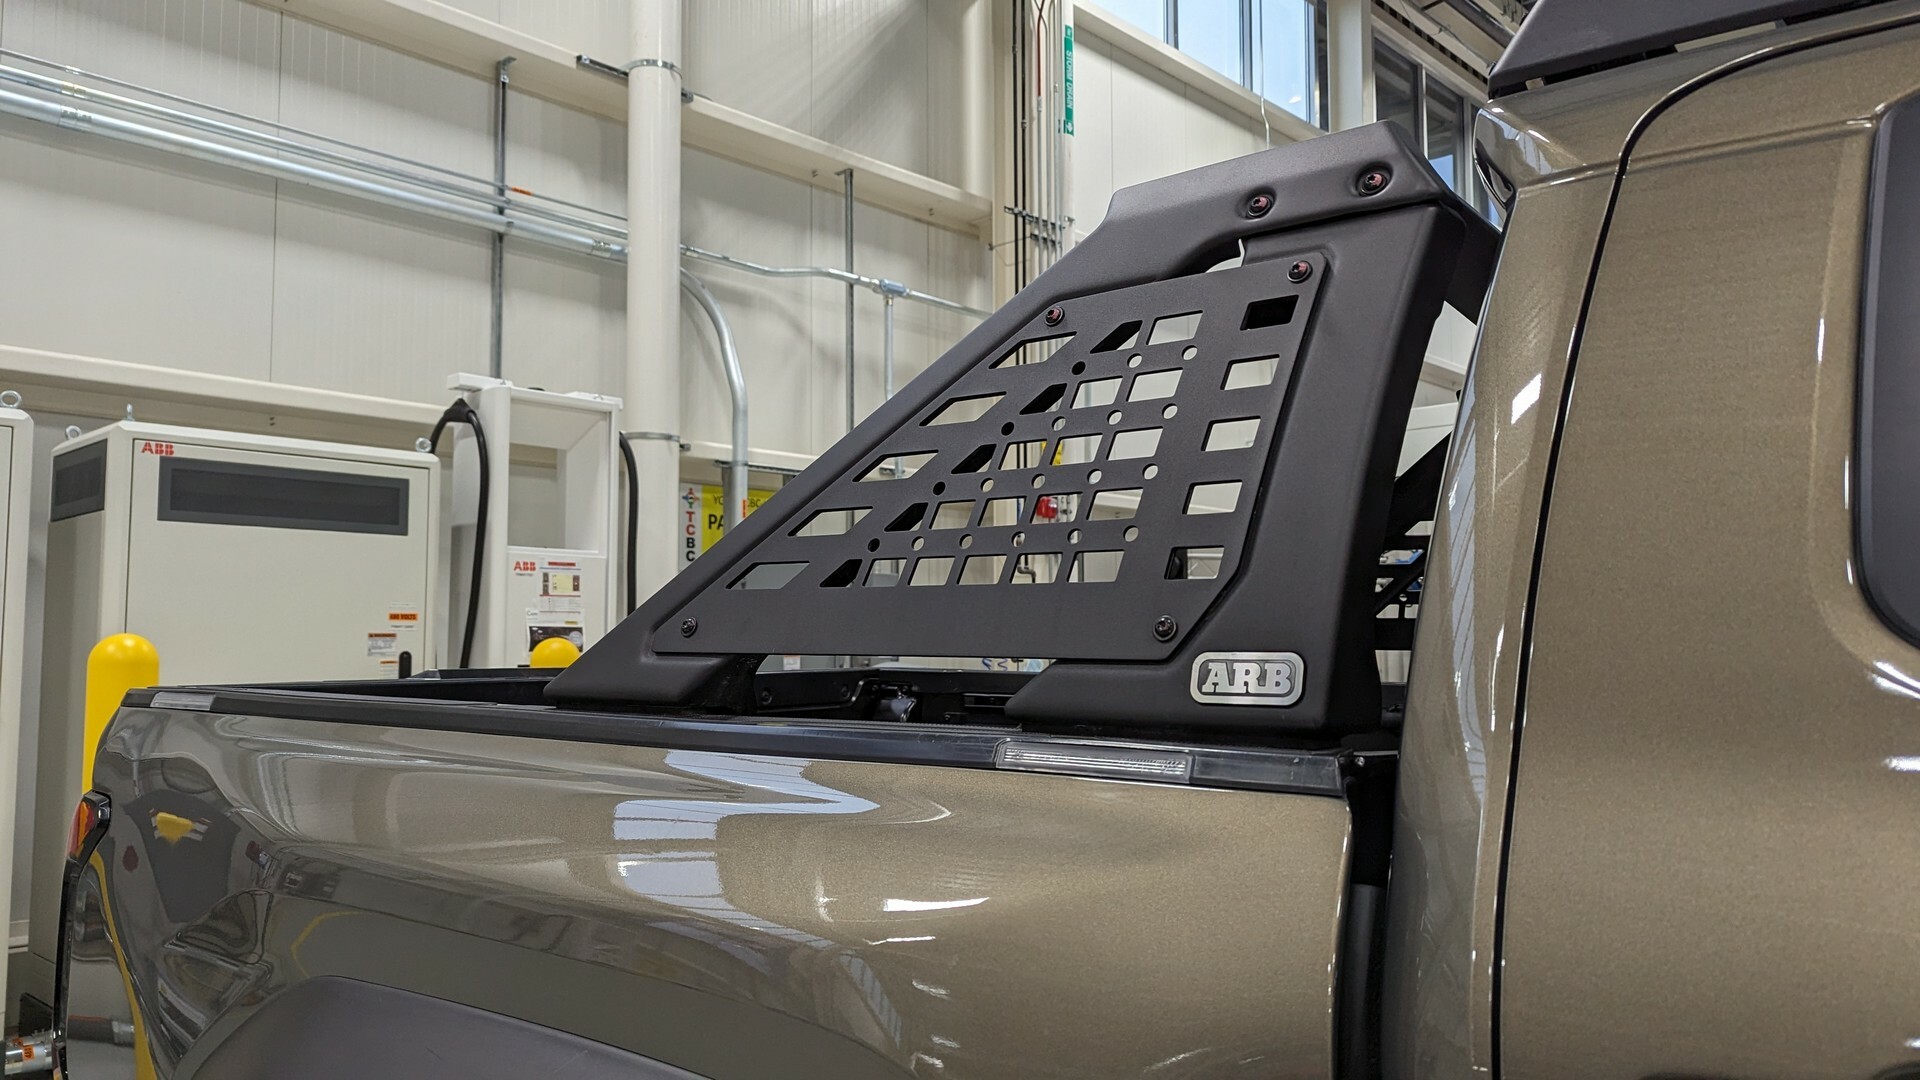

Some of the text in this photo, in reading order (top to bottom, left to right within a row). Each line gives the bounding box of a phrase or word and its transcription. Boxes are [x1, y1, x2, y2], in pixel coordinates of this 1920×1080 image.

[141, 441, 175, 456] ABB
[514, 561, 536, 571] ABB
[1201, 662, 1291, 694] ARB
